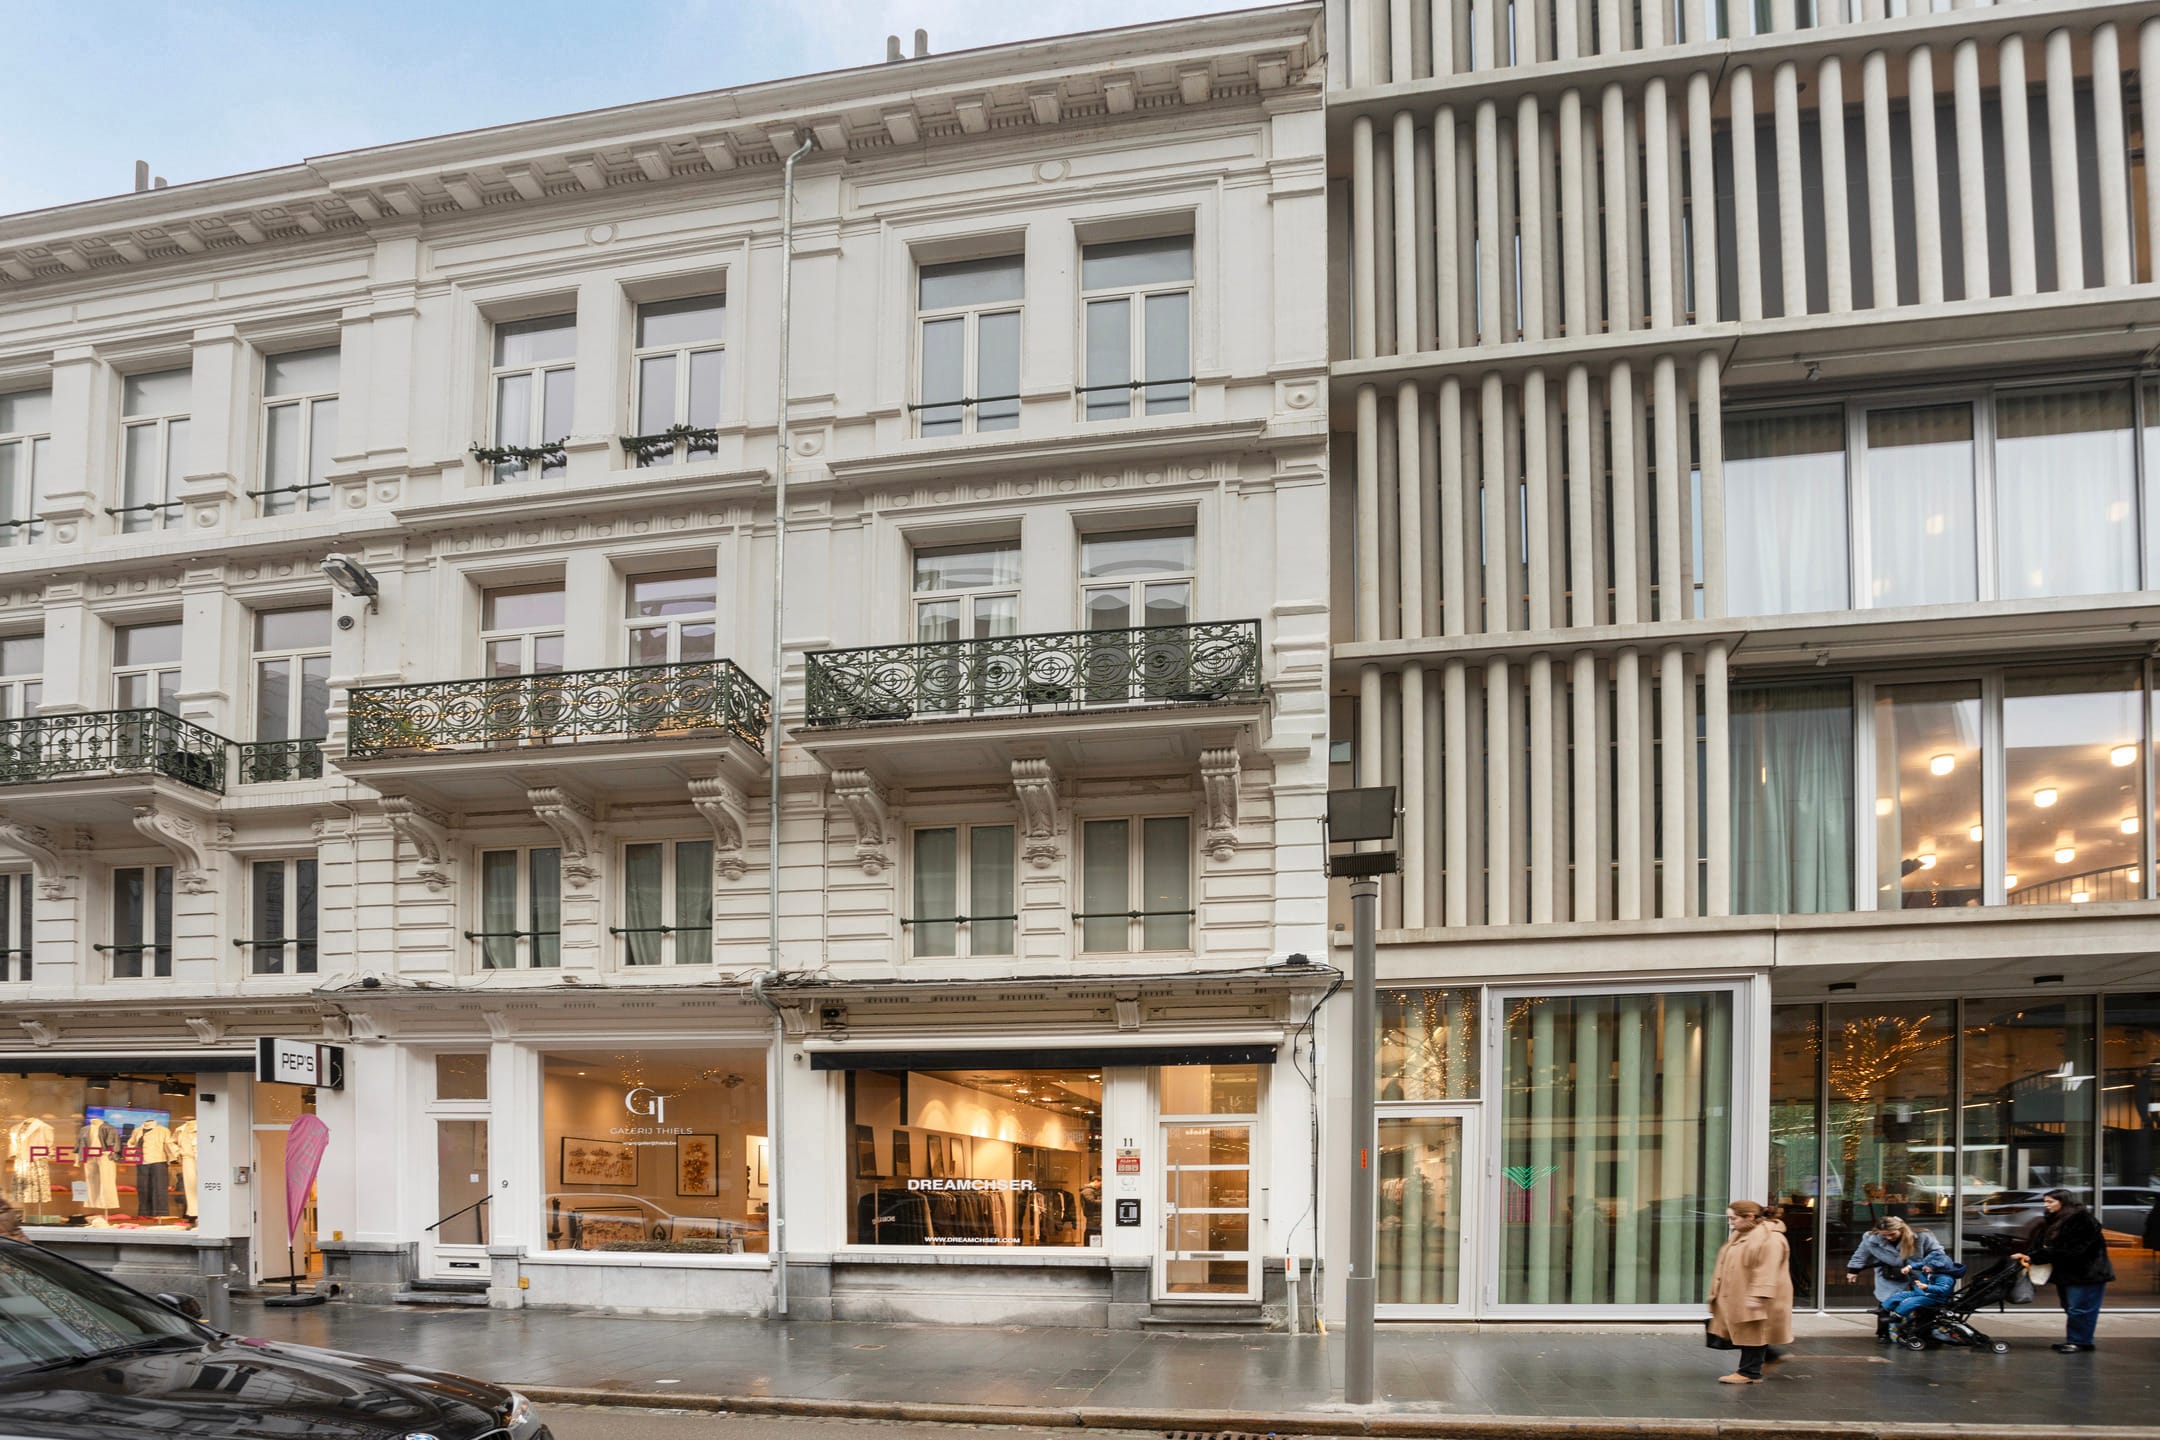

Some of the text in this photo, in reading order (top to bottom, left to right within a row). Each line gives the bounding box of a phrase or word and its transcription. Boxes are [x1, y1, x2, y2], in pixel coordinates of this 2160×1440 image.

[282, 1052, 314, 1072] PEP'S
[609, 1127, 693, 1135] GALERIJ THIELS
[209, 1135, 216, 1143] 7
[1123, 1137, 1133, 1147] 11
[30, 1146, 143, 1165] PEP'S
[501, 1179, 509, 1189] 9
